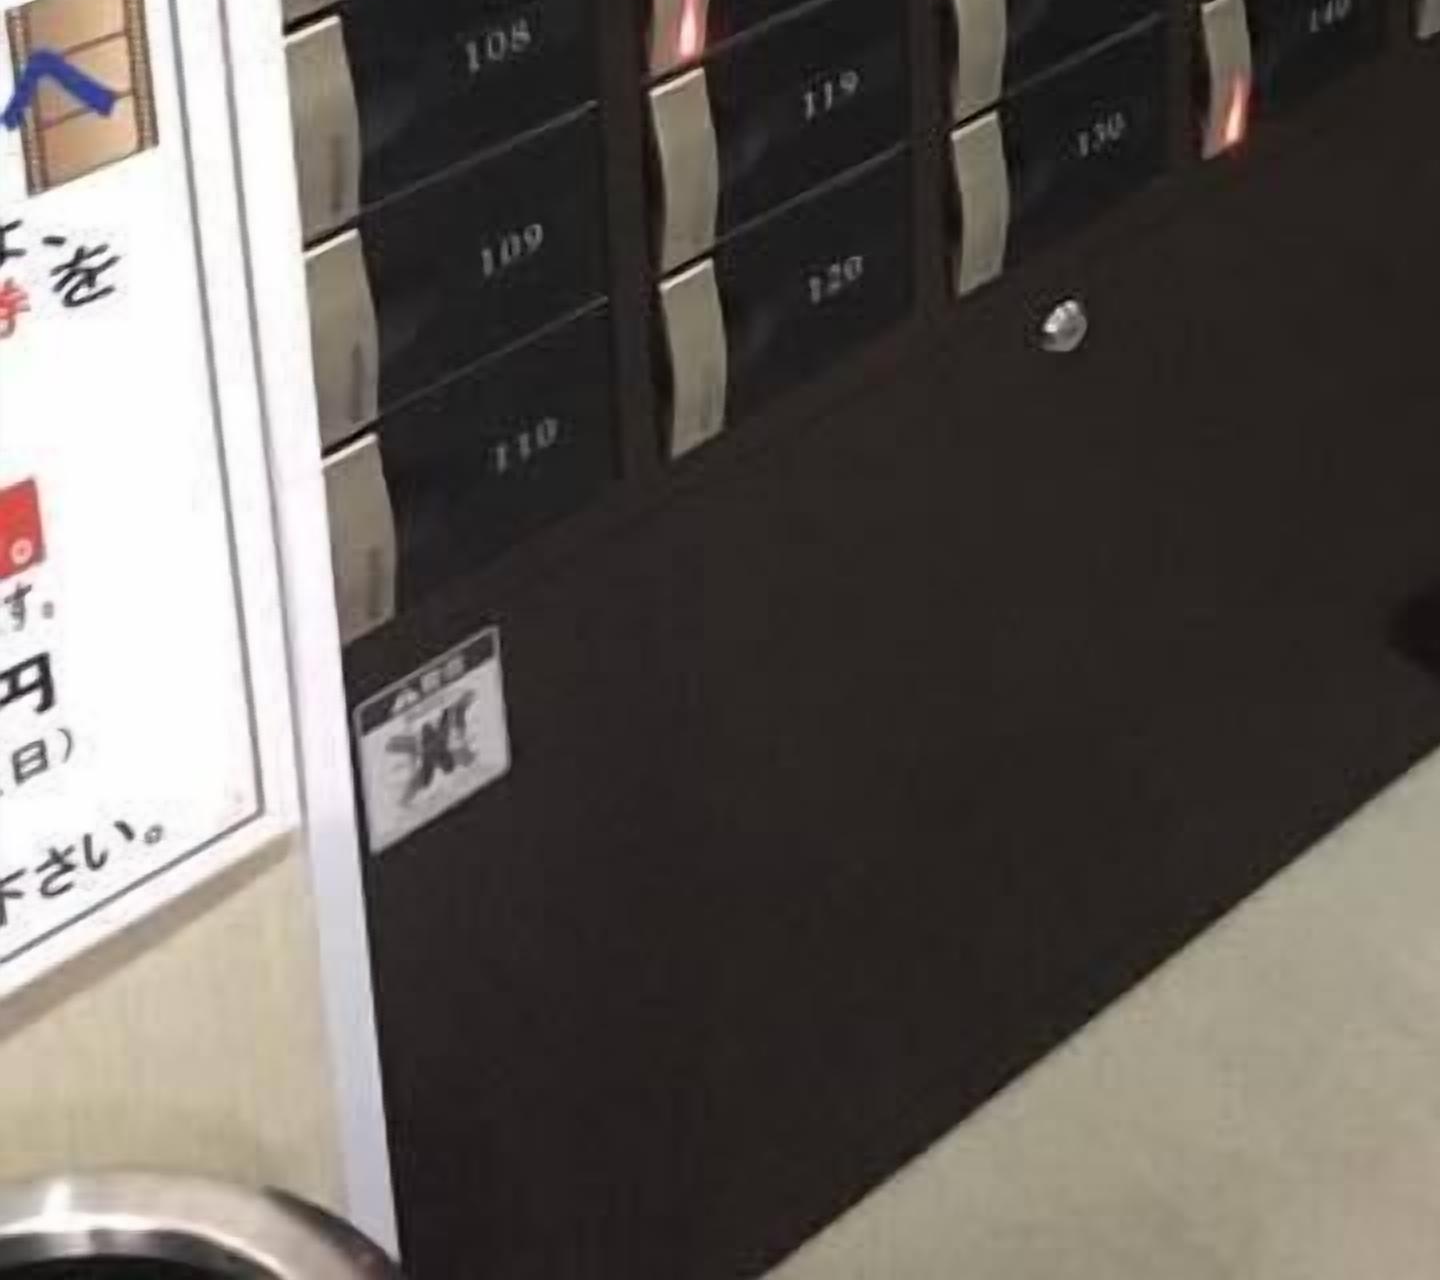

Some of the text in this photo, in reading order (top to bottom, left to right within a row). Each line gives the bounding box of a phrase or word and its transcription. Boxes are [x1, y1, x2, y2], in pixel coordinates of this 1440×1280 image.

[465, 18, 531, 73] 108
[803, 70, 859, 120] 119
[480, 223, 544, 277] 109
[808, 255, 864, 303] 120
[495, 417, 558, 473] 110
[0, 651, 56, 715] 円
